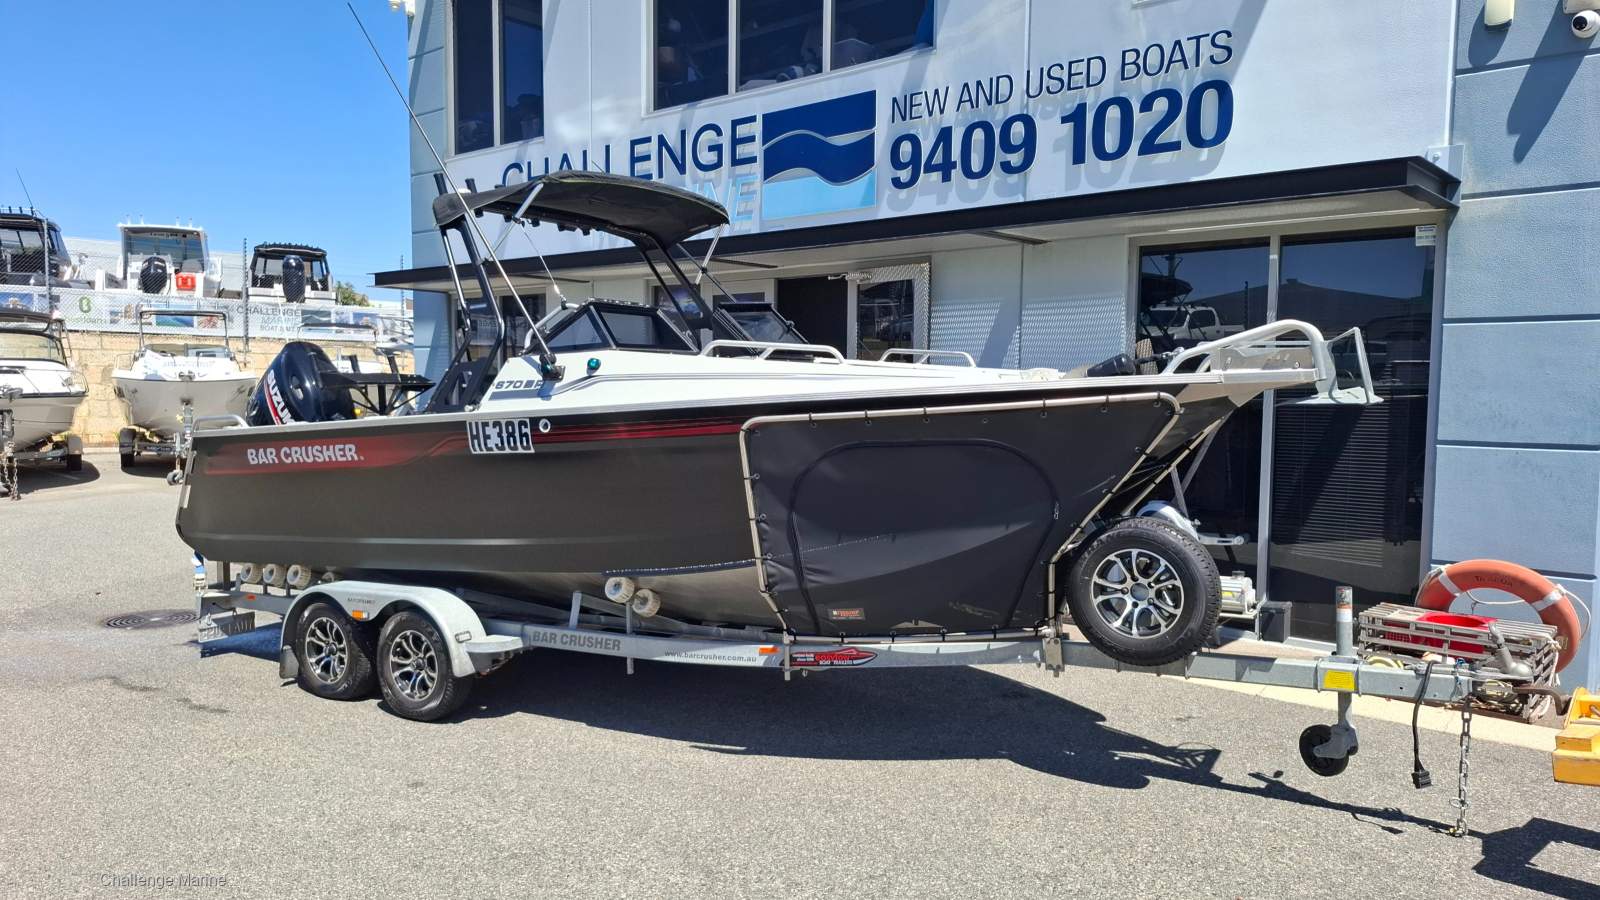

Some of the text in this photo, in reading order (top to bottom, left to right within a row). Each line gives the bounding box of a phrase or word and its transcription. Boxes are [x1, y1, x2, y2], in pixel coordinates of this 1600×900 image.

[891, 29, 1233, 123] NEW AND USED BOATS
[890, 79, 1234, 190] 9409 1020
[268, 369, 296, 424] SUZU
[468, 420, 532, 452] HE386
[247, 443, 359, 465] BAR CRUSHER
[533, 631, 621, 652] BAR CRUSHER
[664, 650, 757, 662] www.barcrusher.com.au
